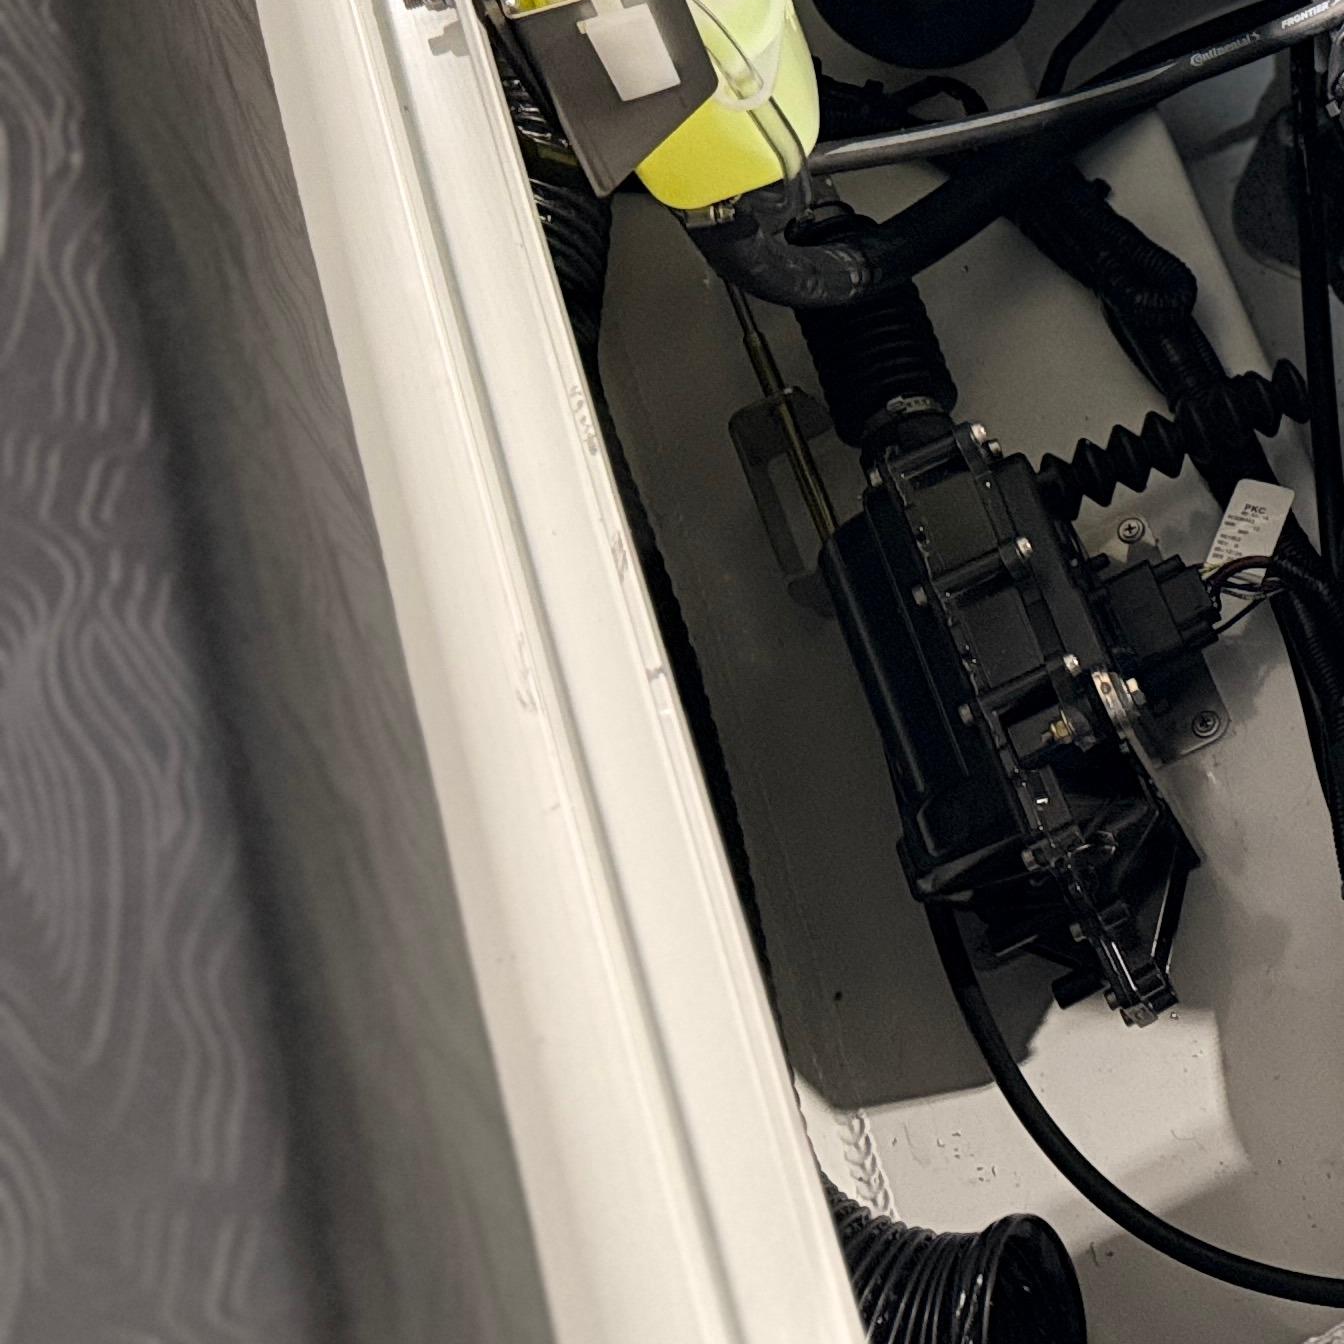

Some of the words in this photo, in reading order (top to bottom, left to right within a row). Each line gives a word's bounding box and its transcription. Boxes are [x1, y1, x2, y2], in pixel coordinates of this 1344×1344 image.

[1281, 0, 1330, 30] FRONTIER
[1190, 32, 1253, 67] Continental
[1243, 503, 1267, 515] PKC
